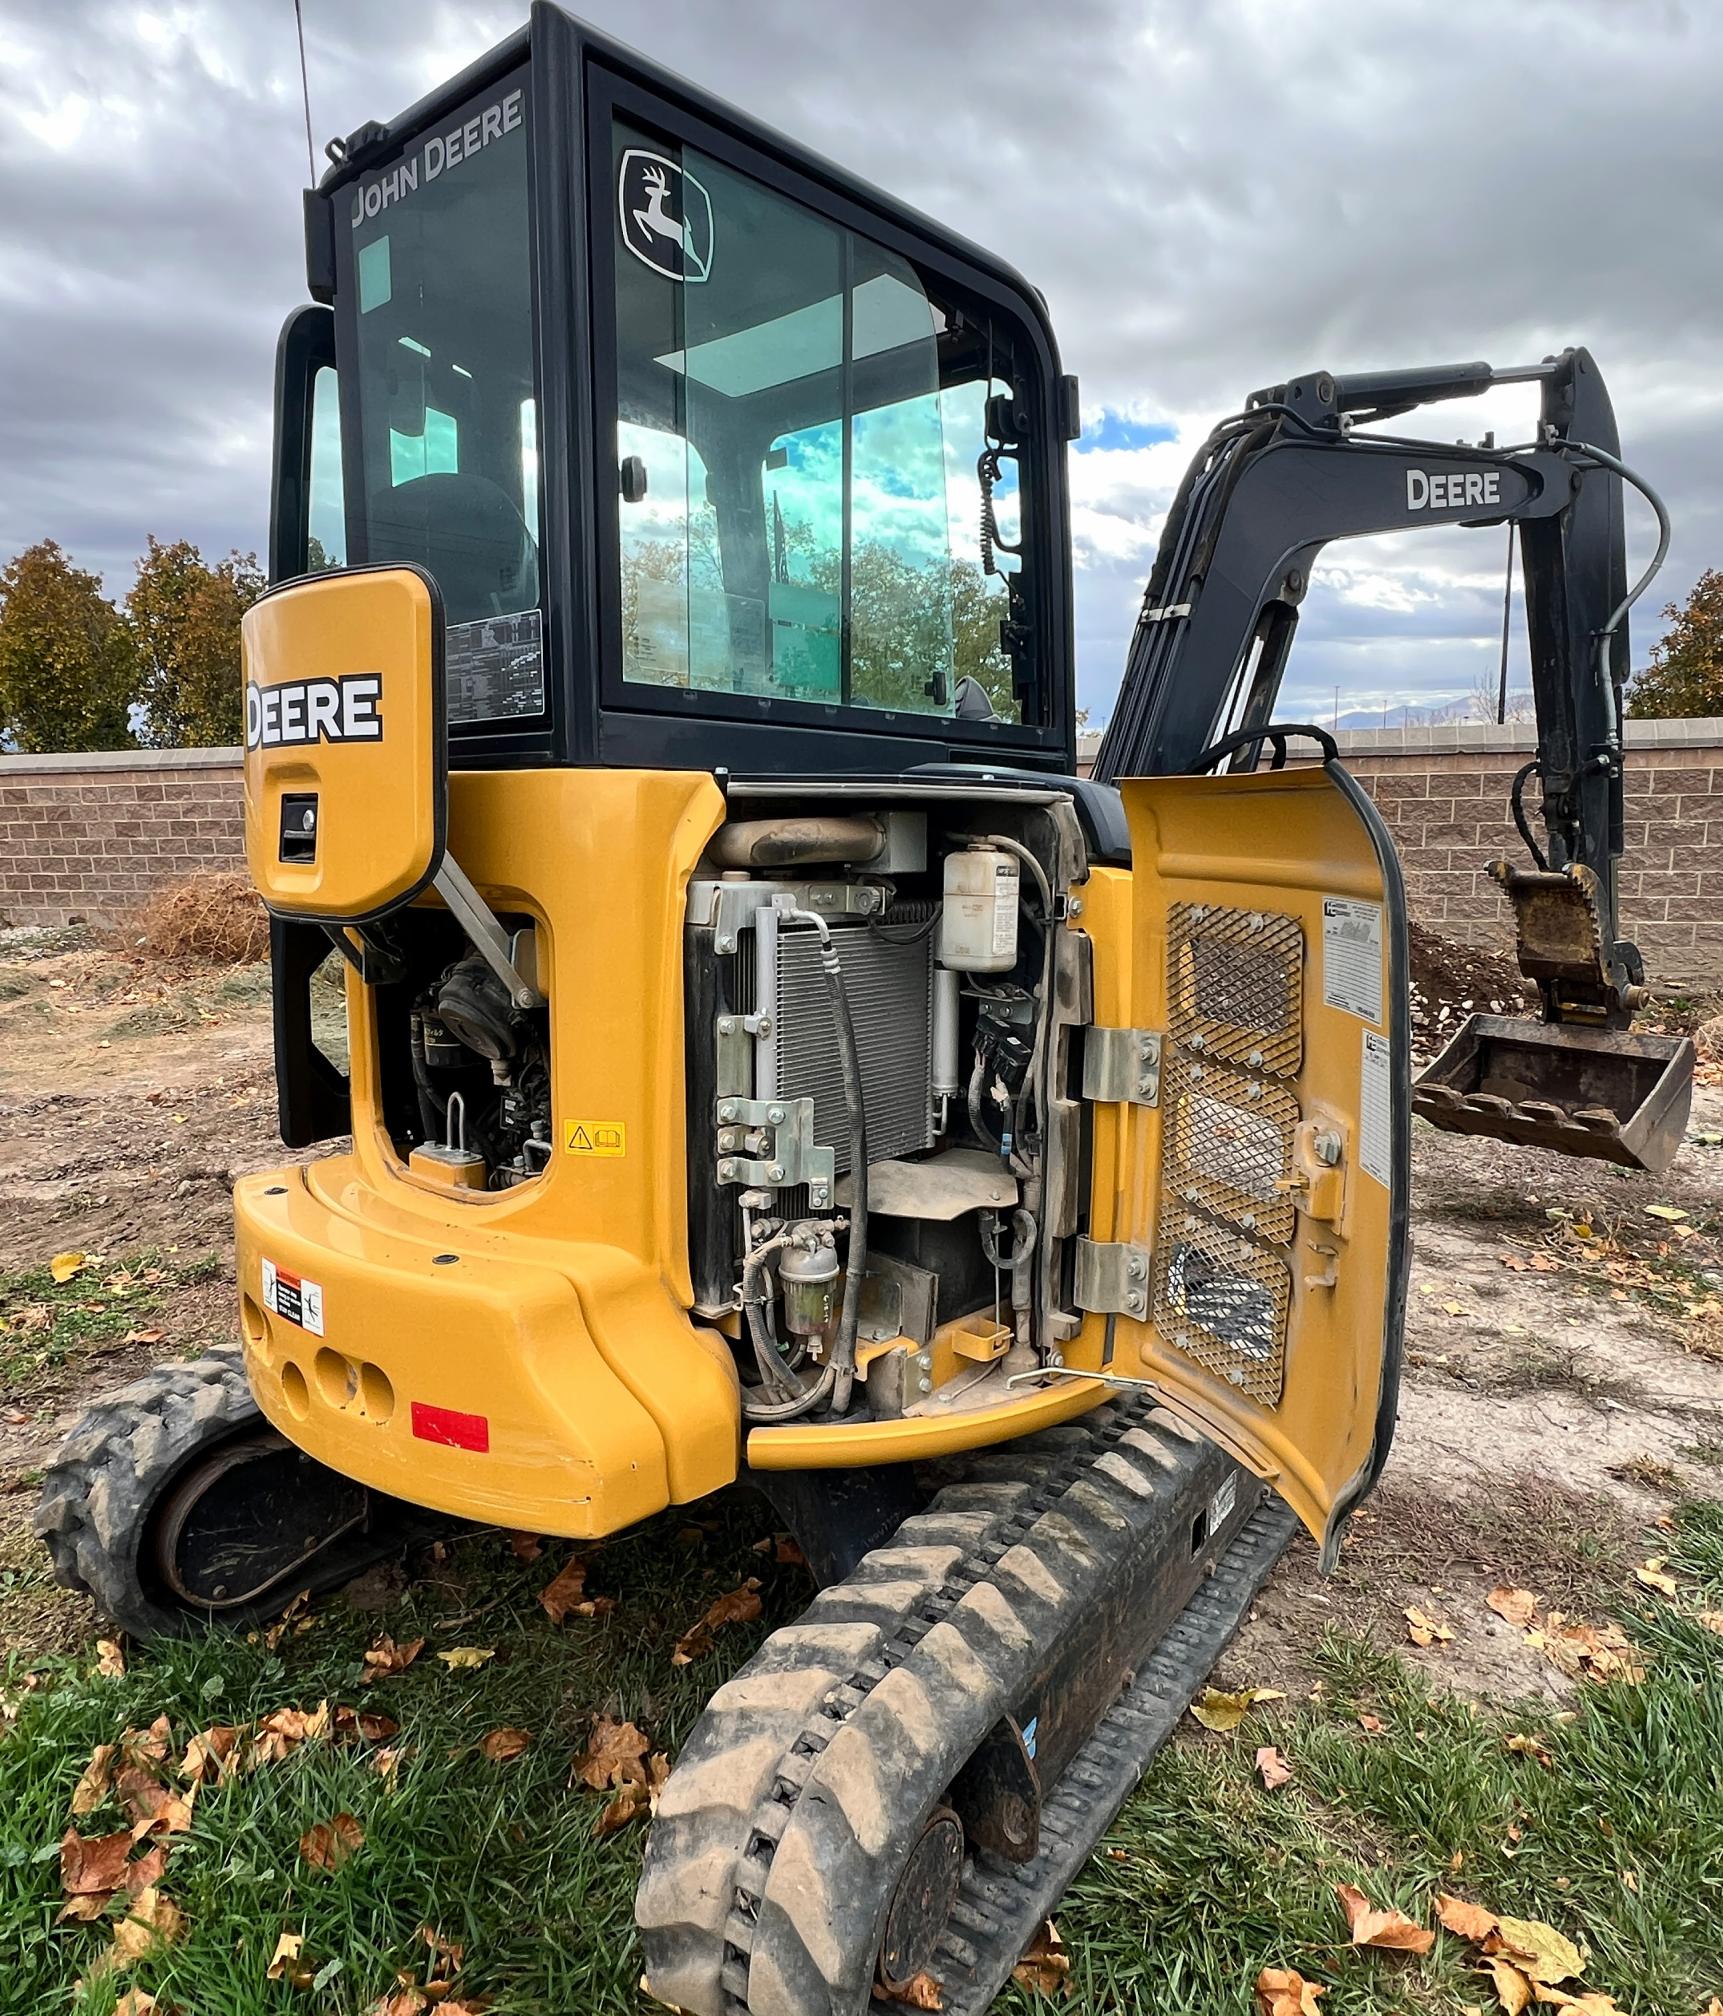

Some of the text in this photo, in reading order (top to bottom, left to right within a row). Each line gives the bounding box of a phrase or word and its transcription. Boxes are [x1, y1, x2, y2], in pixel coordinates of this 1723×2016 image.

[351, 88, 523, 229] JOHN DEERE
[1406, 469, 1500, 510] DEERE
[245, 678, 380, 748] DEERE
